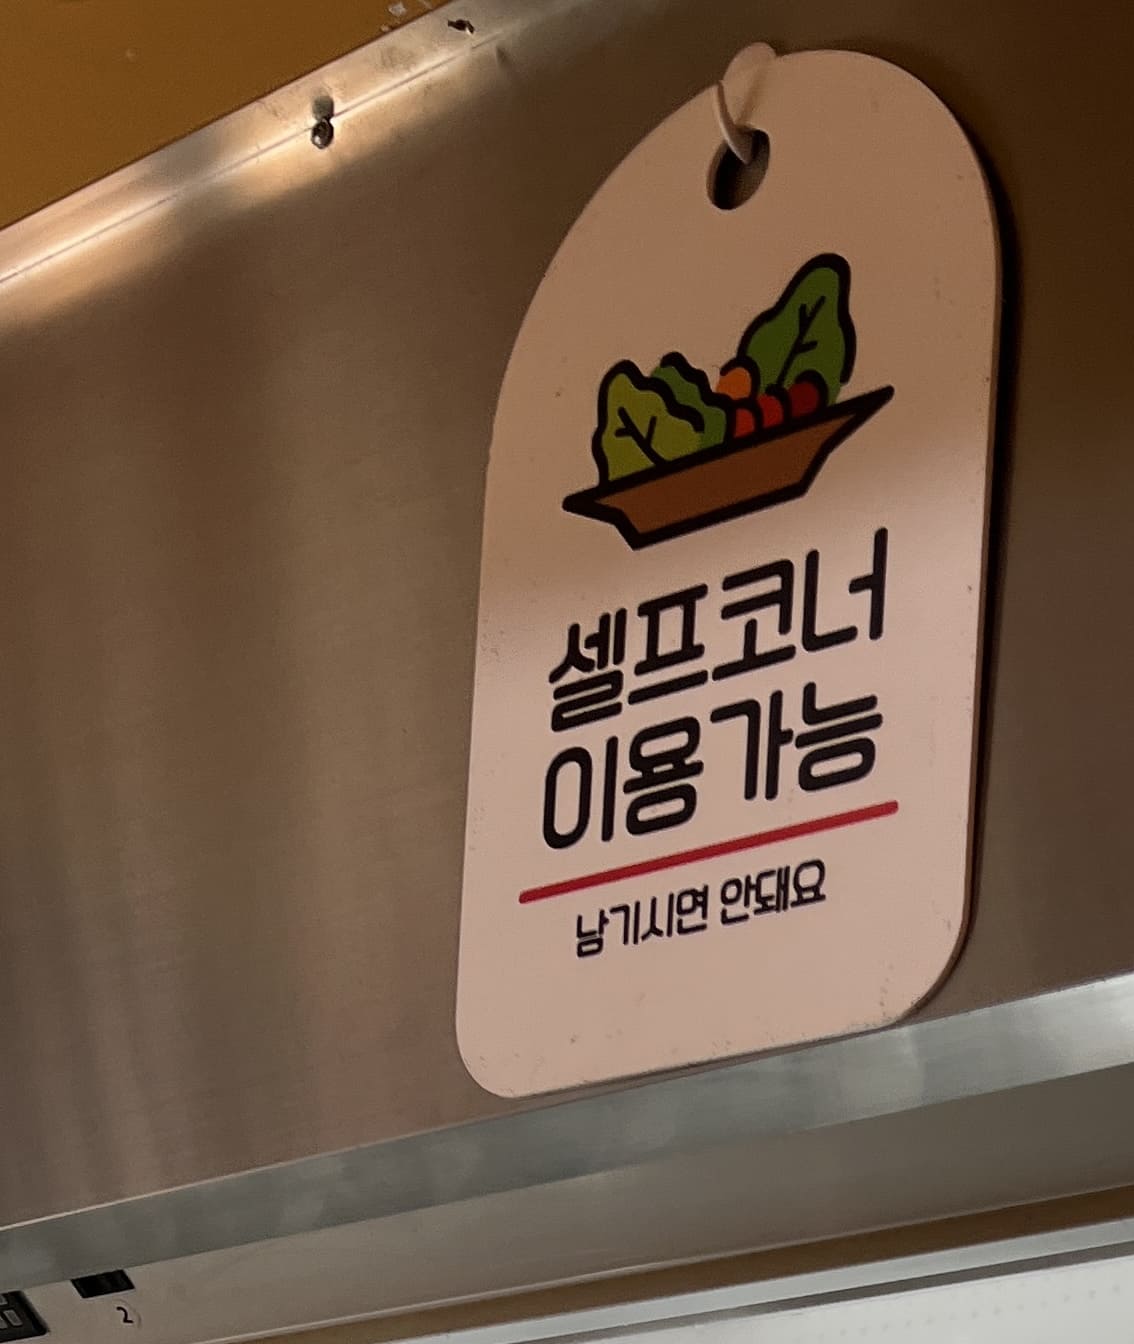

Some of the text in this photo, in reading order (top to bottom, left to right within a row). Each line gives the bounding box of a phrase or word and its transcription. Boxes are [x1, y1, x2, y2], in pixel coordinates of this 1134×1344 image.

[547, 526, 890, 733] 셀프코너
[575, 858, 827, 959] 남기시면 안돼요
